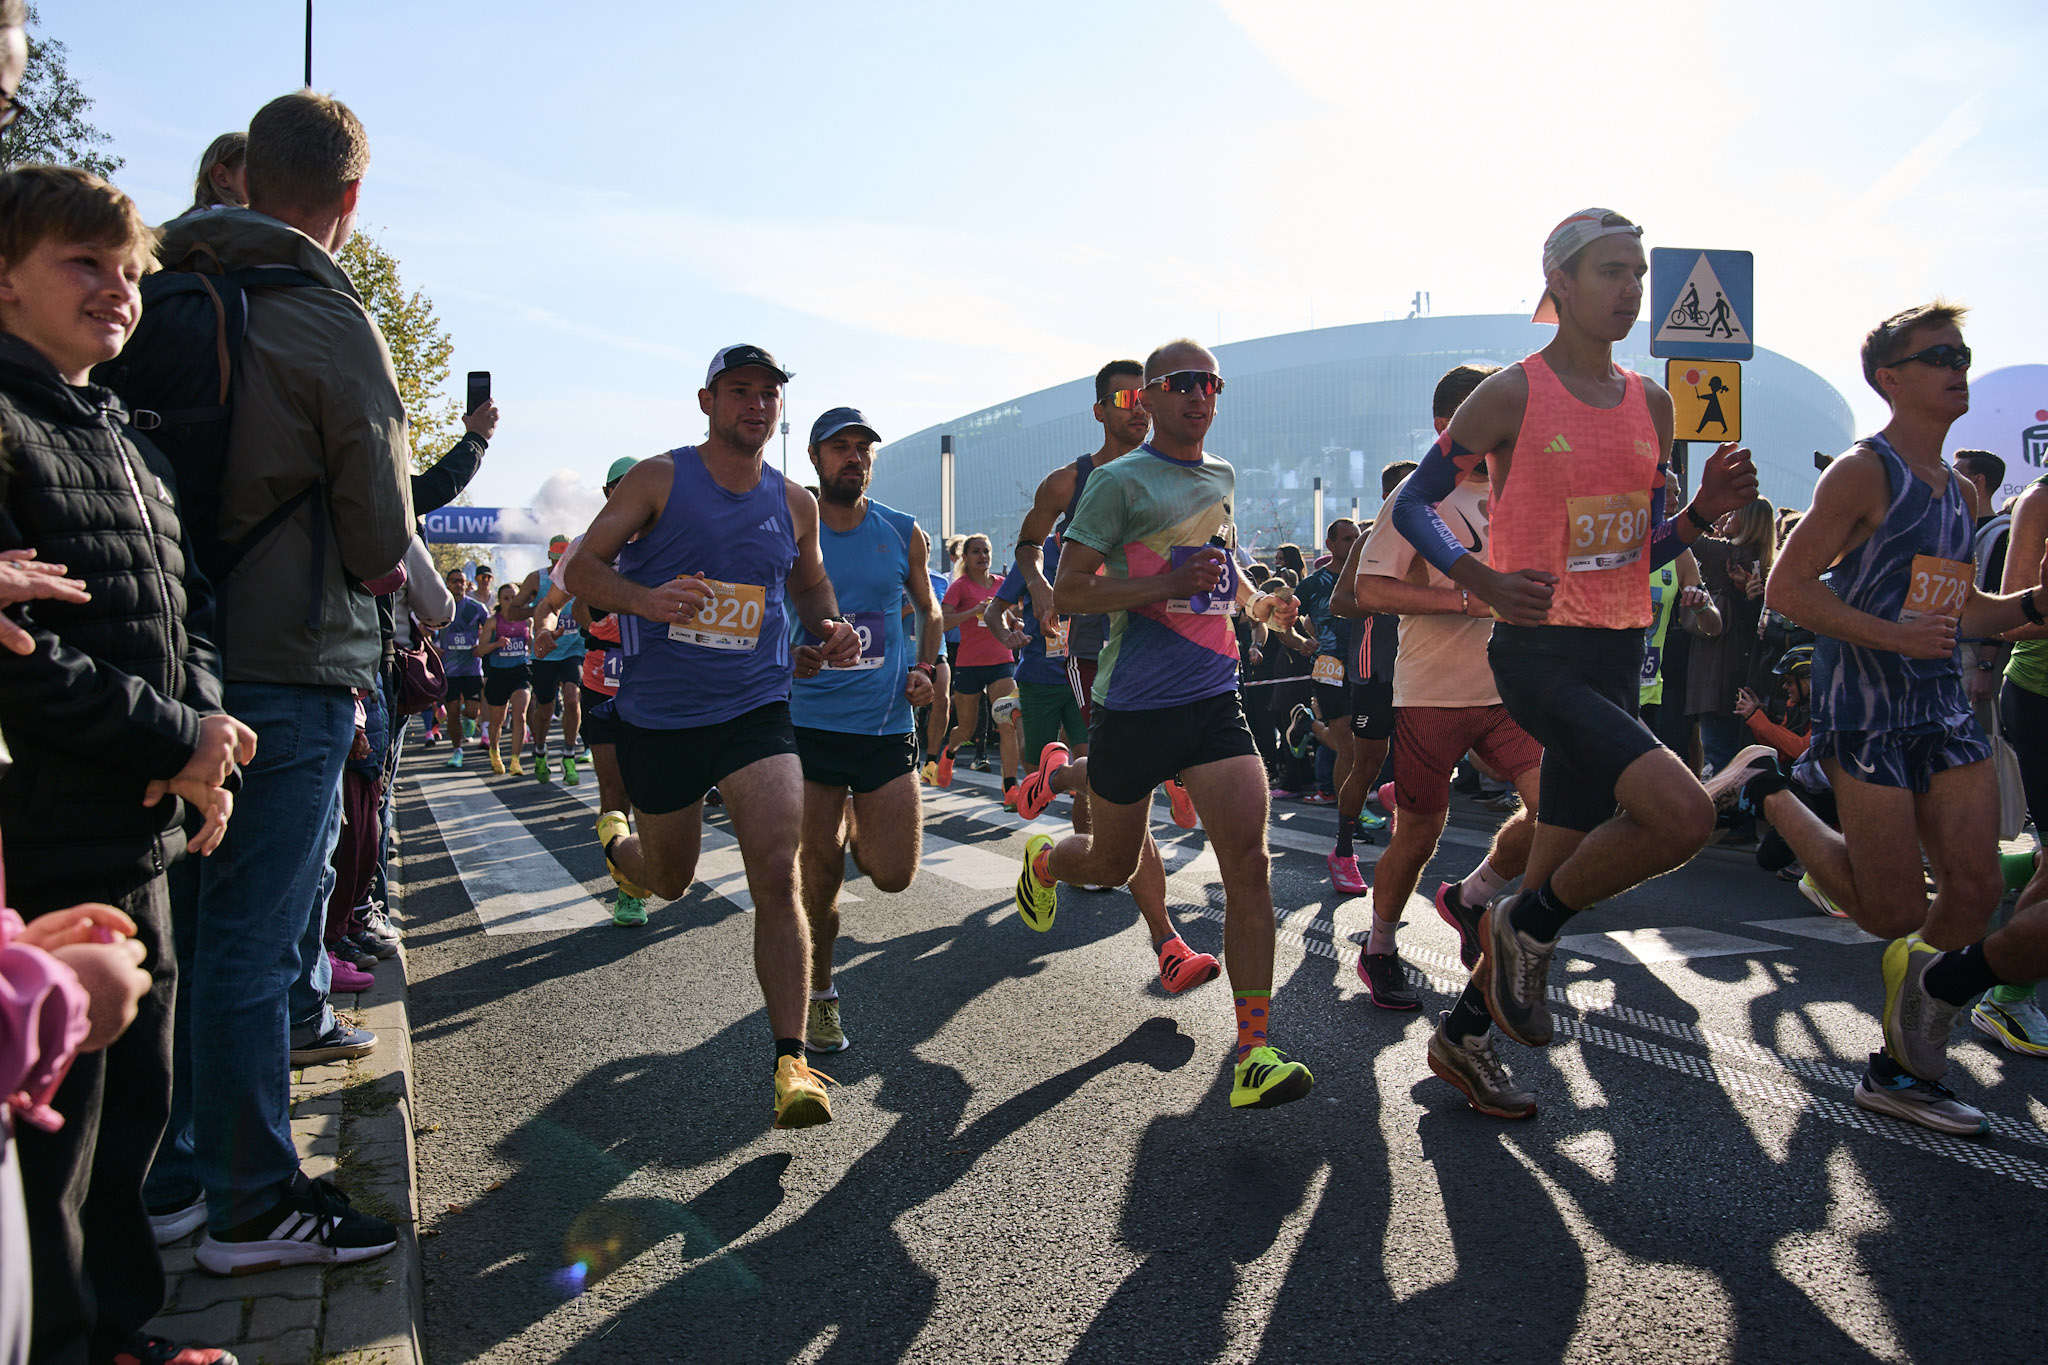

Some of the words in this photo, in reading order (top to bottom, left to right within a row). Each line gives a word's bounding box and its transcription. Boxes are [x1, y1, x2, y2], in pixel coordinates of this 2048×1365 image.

[2003, 483, 2027, 496] Ba
[1575, 508, 1648, 548] 3780
[1911, 571, 1967, 610] 3728
[698, 596, 760, 630] 820
[454, 636, 466, 645] 98
[607, 656, 623, 675] 1
[1641, 656, 1655, 674] 5
